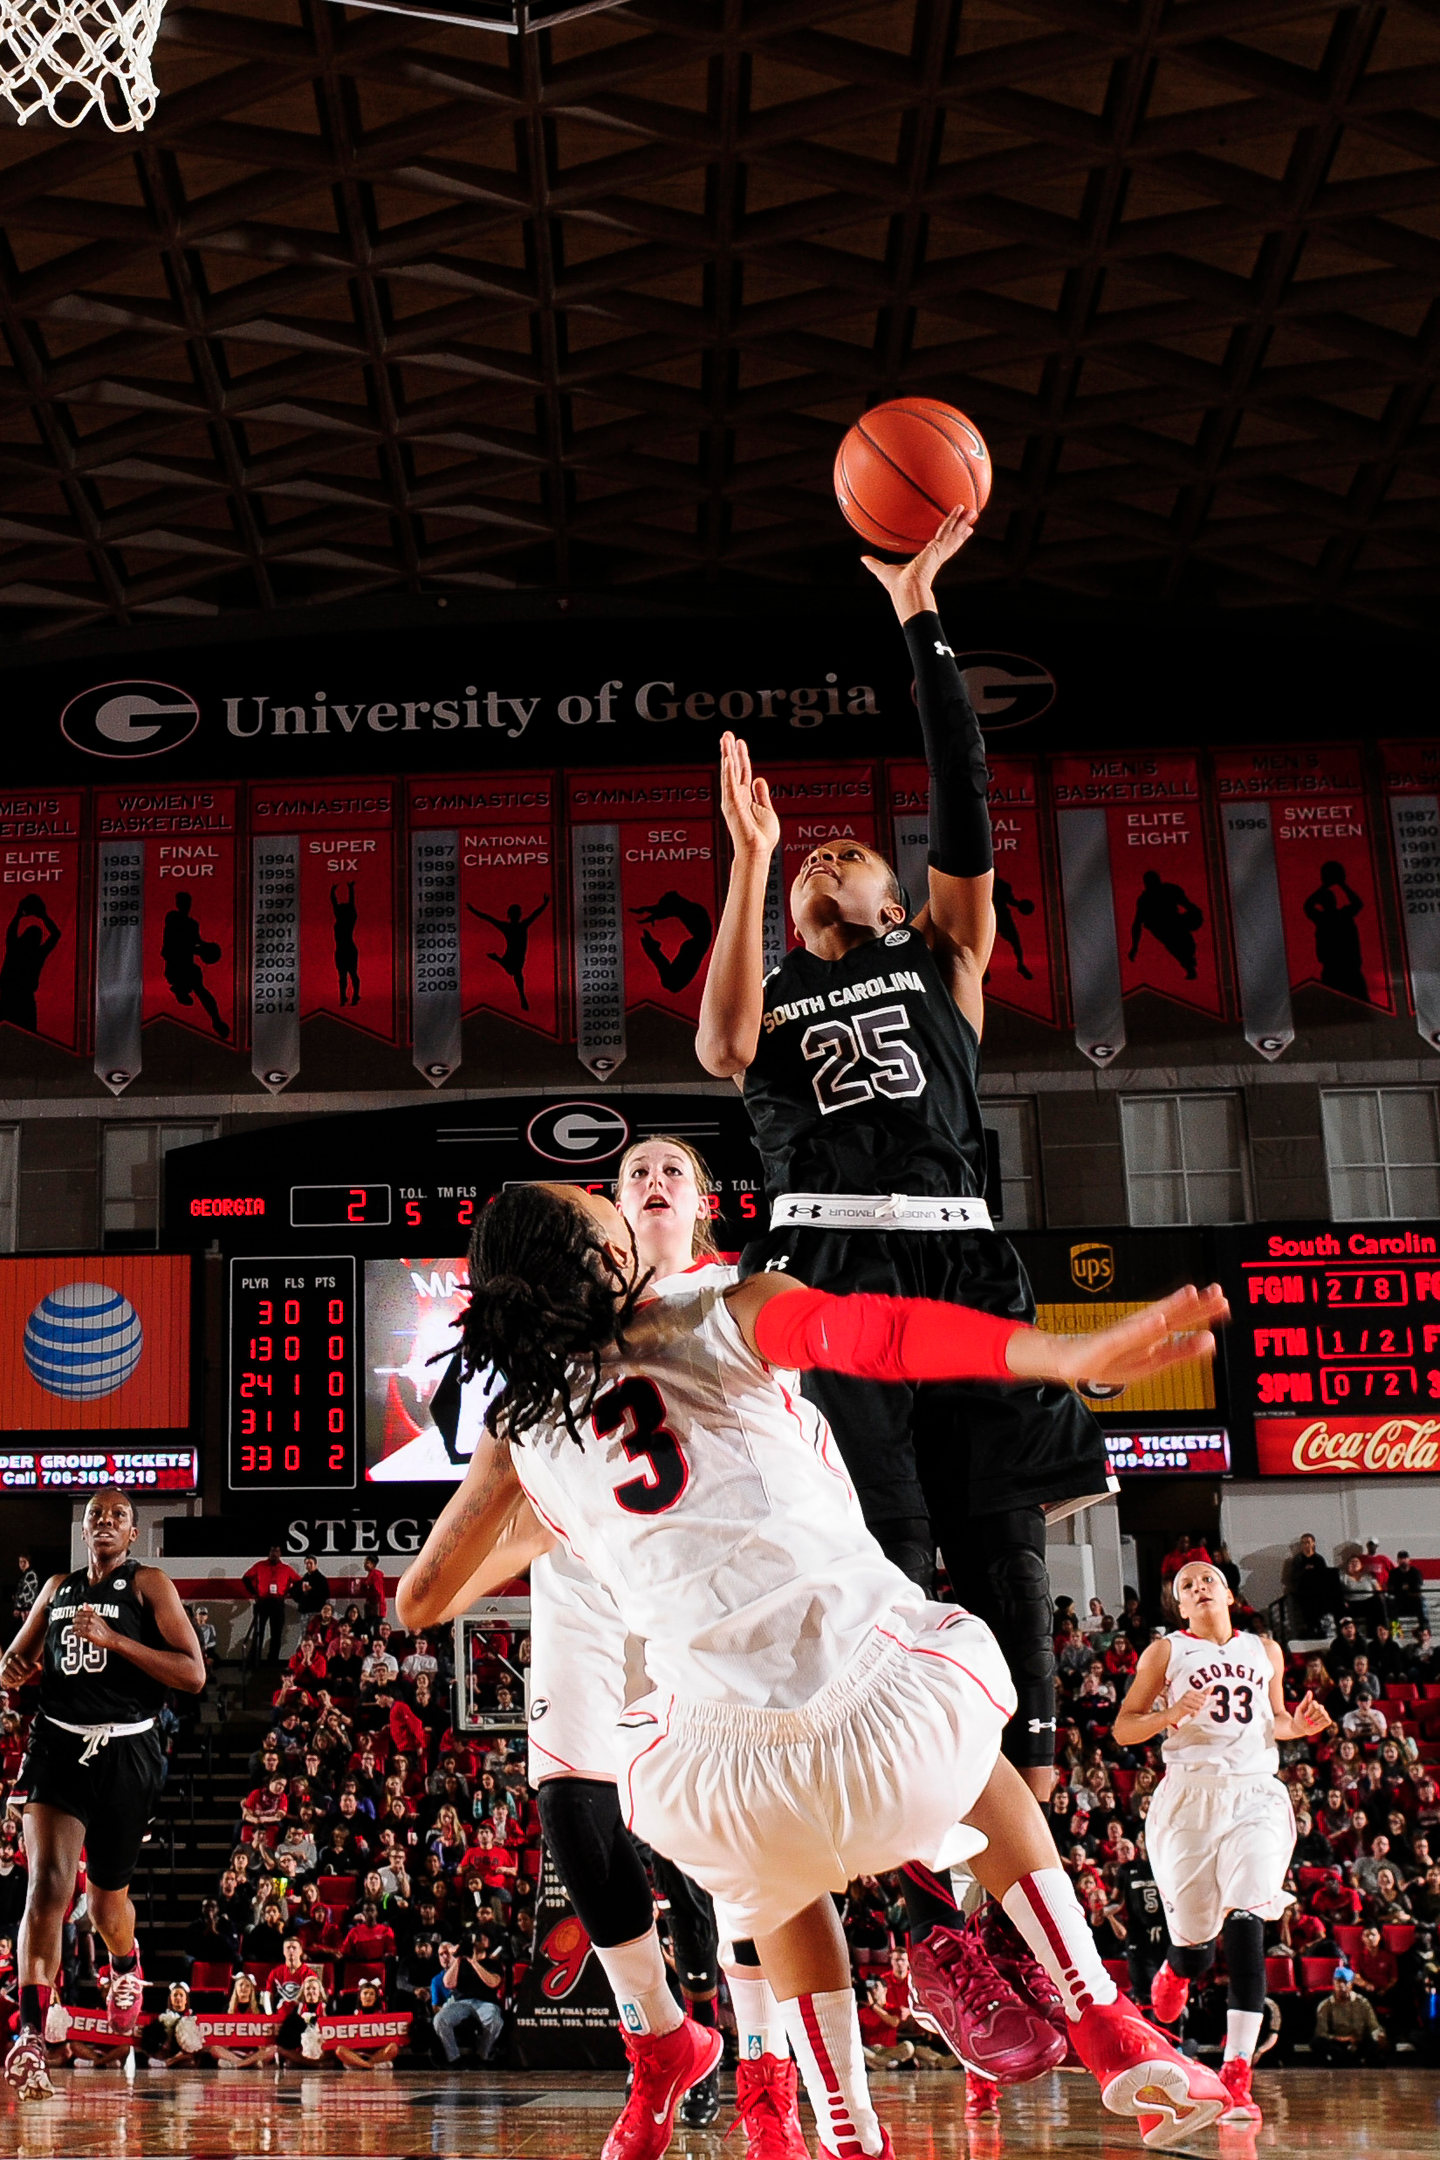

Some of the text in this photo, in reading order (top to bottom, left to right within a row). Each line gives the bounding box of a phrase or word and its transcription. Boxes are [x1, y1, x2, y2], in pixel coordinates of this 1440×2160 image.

[222, 672, 883, 739] University of Georgia
[1056, 781, 1198, 801] BASKETBALL
[1219, 775, 1361, 795] BASKETBALL
[119, 794, 215, 812] WOMEN'S
[414, 791, 551, 811] GYMNASTICS
[573, 786, 712, 806] GYMNASTICS
[256, 797, 392, 817] GYMNASTICS
[1284, 804, 1354, 820] SWEET
[100, 815, 233, 834] BASKETBALL
[1127, 812, 1186, 827] ELITE
[1228, 818, 1267, 831] 1996
[647, 830, 688, 844] SEC
[798, 824, 856, 838] NCAA
[1279, 823, 1362, 839] SIXTEEN
[464, 835, 548, 848] NATIONAL
[901, 834, 927, 845] 198
[1127, 831, 1191, 846] EIGHT
[159, 845, 220, 859] FINAL
[308, 840, 377, 854] SUPER
[418, 845, 455, 857] 1987
[625, 846, 712, 862] CHAMPS
[5, 850, 60, 864] ELITE
[103, 855, 140, 866] 1983
[258, 855, 295, 865] 1994
[463, 851, 550, 867] CHAMPS
[582, 856, 614, 865] 1987
[159, 864, 215, 878] FOUR
[327, 858, 359, 872] SIX
[418, 860, 455, 872] 1989
[3, 869, 63, 883] EIGHT
[103, 870, 141, 881] 1985
[258, 869, 295, 880] 1995
[582, 869, 611, 878] 1991
[418, 875, 456, 887] 1993
[583, 881, 615, 891] 1992
[102, 886, 141, 897] 1995
[258, 884, 295, 894] 1996
[258, 899, 295, 909] 1997
[418, 891, 456, 903] 1998
[102, 901, 140, 911] 1996
[418, 906, 456, 918] 1999
[102, 916, 139, 927] 1999
[255, 913, 296, 923] 2000
[255, 928, 292, 938] 2001
[416, 922, 457, 934] 2005
[583, 931, 617, 941] 1997
[255, 942, 295, 953] 2002
[416, 938, 457, 949] 2006
[255, 957, 295, 968] 2003
[417, 953, 456, 964] 2007
[584, 957, 618, 966] 1999
[255, 972, 295, 983] 2004
[418, 968, 456, 978] 2008
[582, 969, 615, 979] 2001
[255, 987, 295, 998] 2013
[418, 981, 458, 992] 2009
[582, 982, 619, 992] 2002
[582, 995, 619, 1005] 2004
[762, 970, 927, 1034] SOUTH CAROLINA
[255, 1003, 295, 1013] 2014
[583, 1021, 620, 1031] 2006
[584, 1035, 622, 1046] 2008
[800, 1003, 928, 1115] 25
[731, 1179, 762, 1191] T.O.L.
[399, 1186, 478, 1199] T.O.L. TM FLS
[190, 1198, 266, 1217] GEORGIA
[347, 1189, 474, 1226] 2 5 2
[740, 1193, 756, 1219] 5
[1268, 1231, 1437, 1257] South Carolin
[1073, 1257, 1111, 1284] ups
[242, 1276, 336, 1290] PLYR FLS PTS
[1248, 1275, 1305, 1304] FGM
[258, 1299, 344, 1325] 3 0 0
[249, 1335, 344, 1361] 13 0 0
[1253, 1327, 1309, 1357] FTM
[240, 1371, 344, 1398] 24 1 0
[1257, 1372, 1313, 1404] 3PM
[241, 1407, 344, 1434] 31 1 0
[592, 1375, 690, 1515] 3
[1138, 1434, 1222, 1452] TICKETS
[1291, 1420, 1440, 1472] Coca-Cola
[40, 1454, 107, 1469] GROUP
[111, 1453, 192, 1468] TICKETS
[241, 1444, 344, 1471] 33 0 2
[2, 1470, 157, 1485] Call 706-369-6218
[1188, 1662, 1264, 1690] GEORGIA
[1210, 1684, 1253, 1724] 33
[1143, 1887, 1160, 1914] 5
[321, 2021, 409, 2040] DEFENSE
